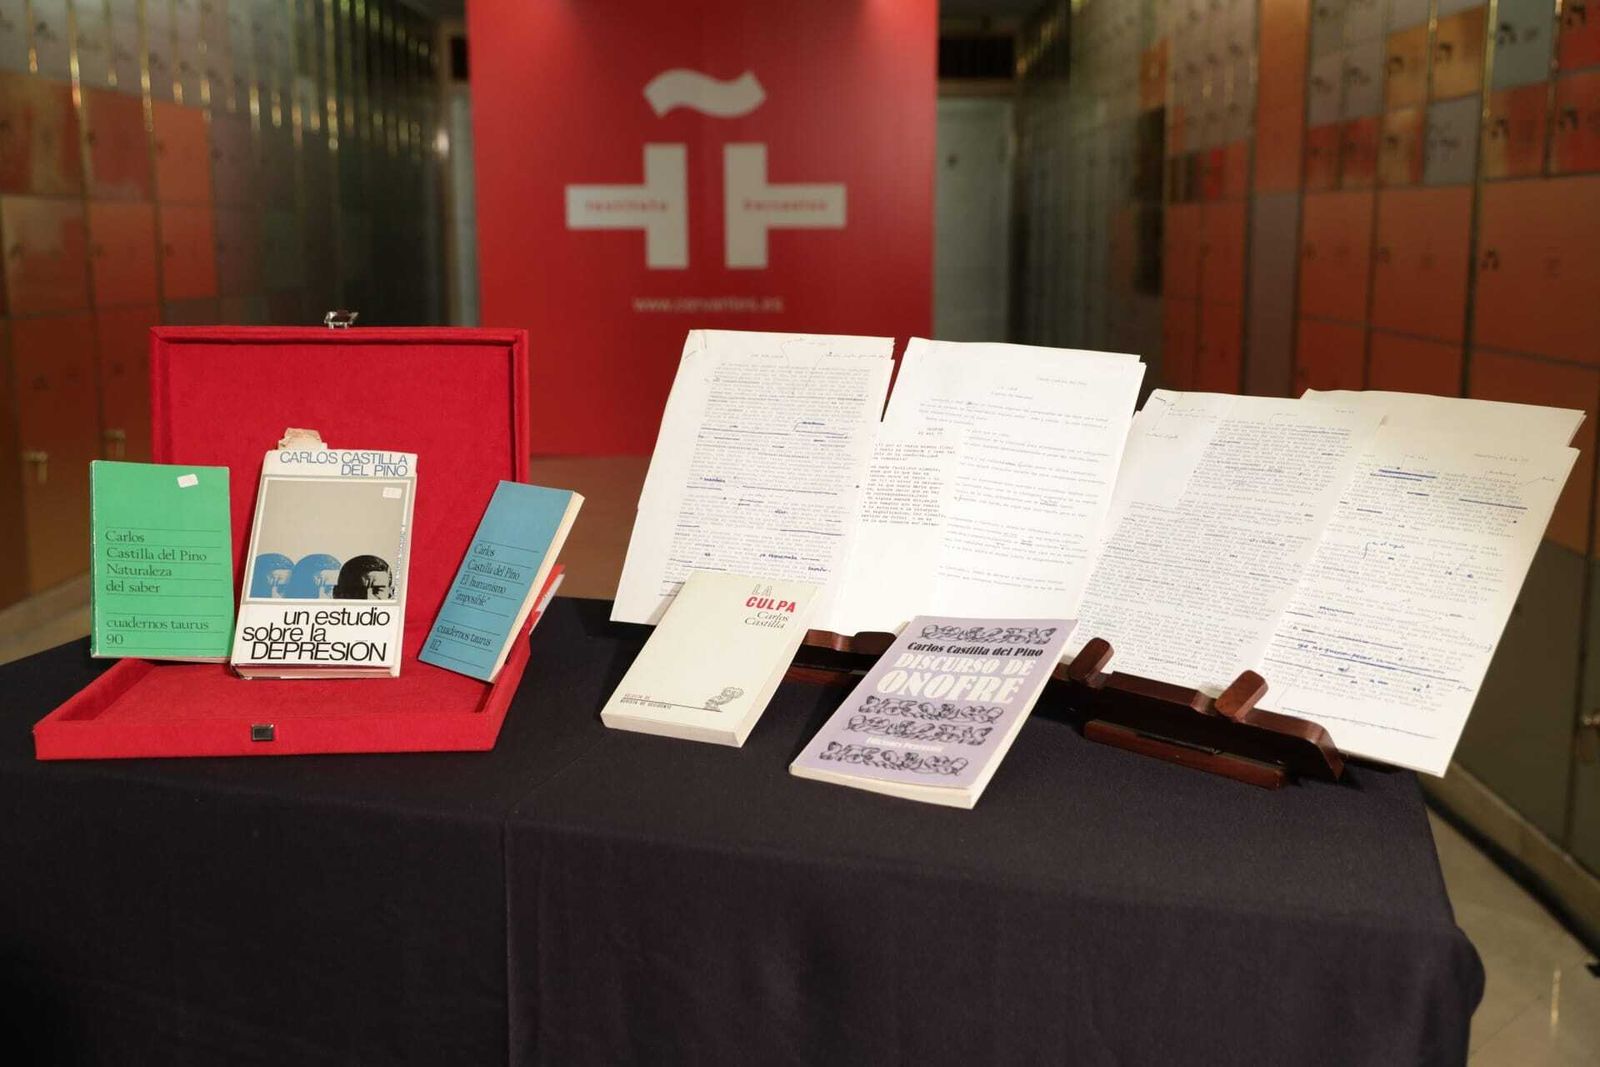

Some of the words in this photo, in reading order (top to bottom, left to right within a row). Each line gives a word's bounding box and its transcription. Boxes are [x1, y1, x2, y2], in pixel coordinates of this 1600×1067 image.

[279, 451, 338, 465] CARLOS
[341, 453, 408, 466] CASTILLA
[341, 464, 369, 476] DEL
[374, 465, 408, 477] PINO
[105, 530, 145, 543] Carlos
[106, 547, 154, 561] Castilla
[157, 549, 177, 561] del
[180, 549, 208, 562] Pino
[474, 543, 496, 557] Carlos
[106, 563, 173, 577] Naturaleza
[468, 559, 494, 575] Castilla
[493, 565, 507, 577] del
[505, 567, 520, 580] Pino
[105, 580, 124, 593] del
[128, 581, 161, 593] saber
[460, 574, 471, 586] El
[469, 575, 507, 594] humanismo
[751, 583, 773, 597] LA
[745, 596, 796, 613] CULPA
[106, 616, 168, 630] cuadernos
[170, 620, 209, 630] taurus
[283, 611, 310, 626] un
[314, 607, 391, 626] estudio
[744, 617, 786, 629] Castilla
[757, 611, 789, 622] Carlos
[105, 633, 124, 645] 90
[242, 622, 304, 642] sobre
[309, 623, 327, 642] la
[437, 625, 471, 642] cuadernos
[470, 634, 492, 647] taurus
[907, 641, 945, 653] Carlos
[946, 645, 989, 656] Castilla
[992, 646, 1013, 657] del
[1014, 646, 1044, 658] Pino
[893, 653, 1000, 674] DISCURSO
[1003, 659, 1036, 676] DE
[876, 670, 1024, 704] ONOFRE
